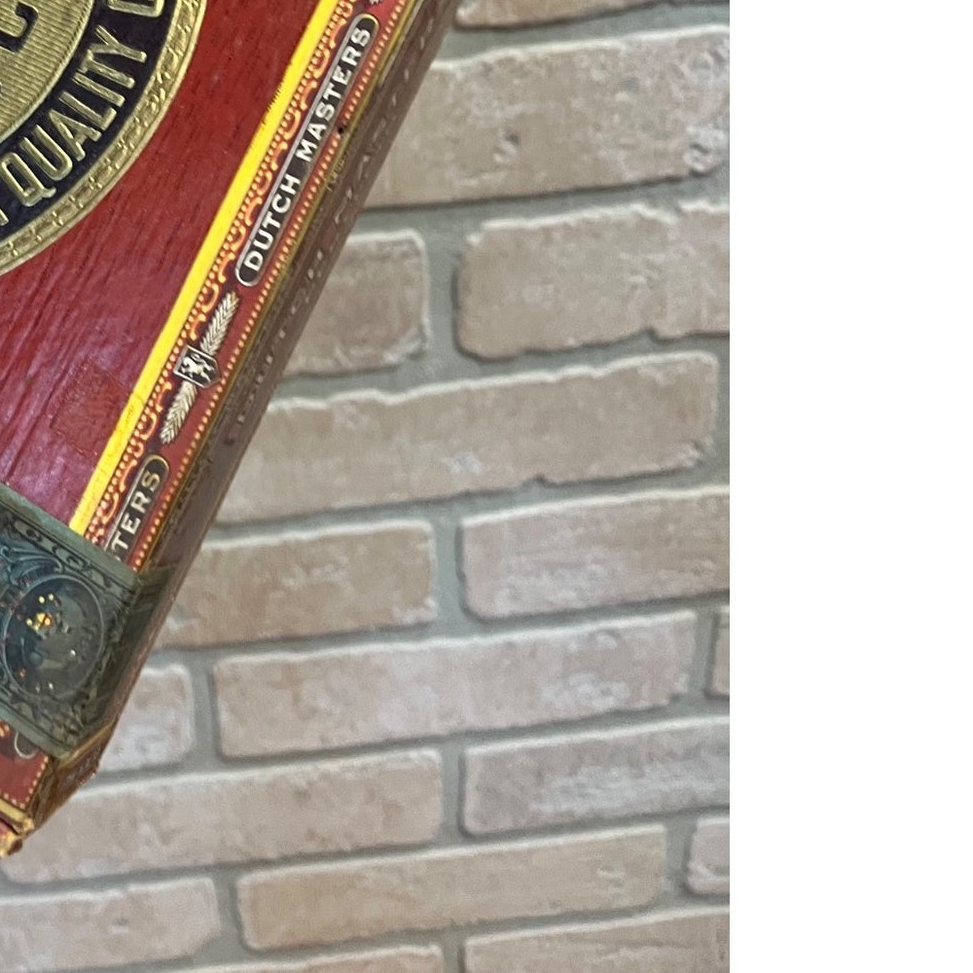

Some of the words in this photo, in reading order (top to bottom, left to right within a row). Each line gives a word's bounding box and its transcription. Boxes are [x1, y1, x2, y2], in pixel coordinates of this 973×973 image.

[244, 174, 301, 271] DUTCH
[296, 27, 371, 162] MASTERS
[110, 469, 160, 561] TERS
